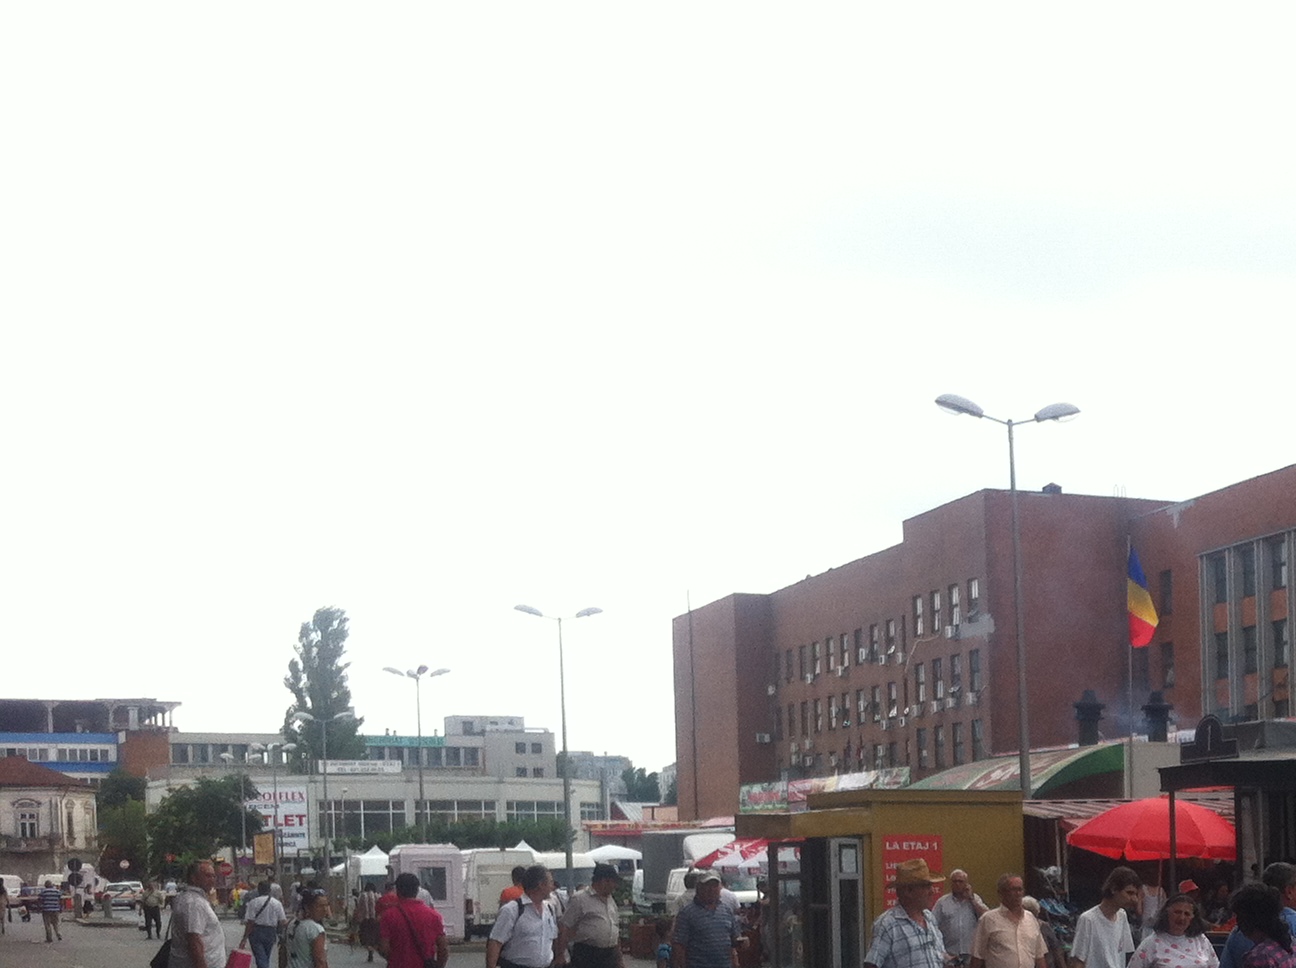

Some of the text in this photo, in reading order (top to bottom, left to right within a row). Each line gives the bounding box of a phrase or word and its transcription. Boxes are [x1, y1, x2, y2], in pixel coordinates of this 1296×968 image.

[885, 841, 938, 851] LA ETAJ 1
